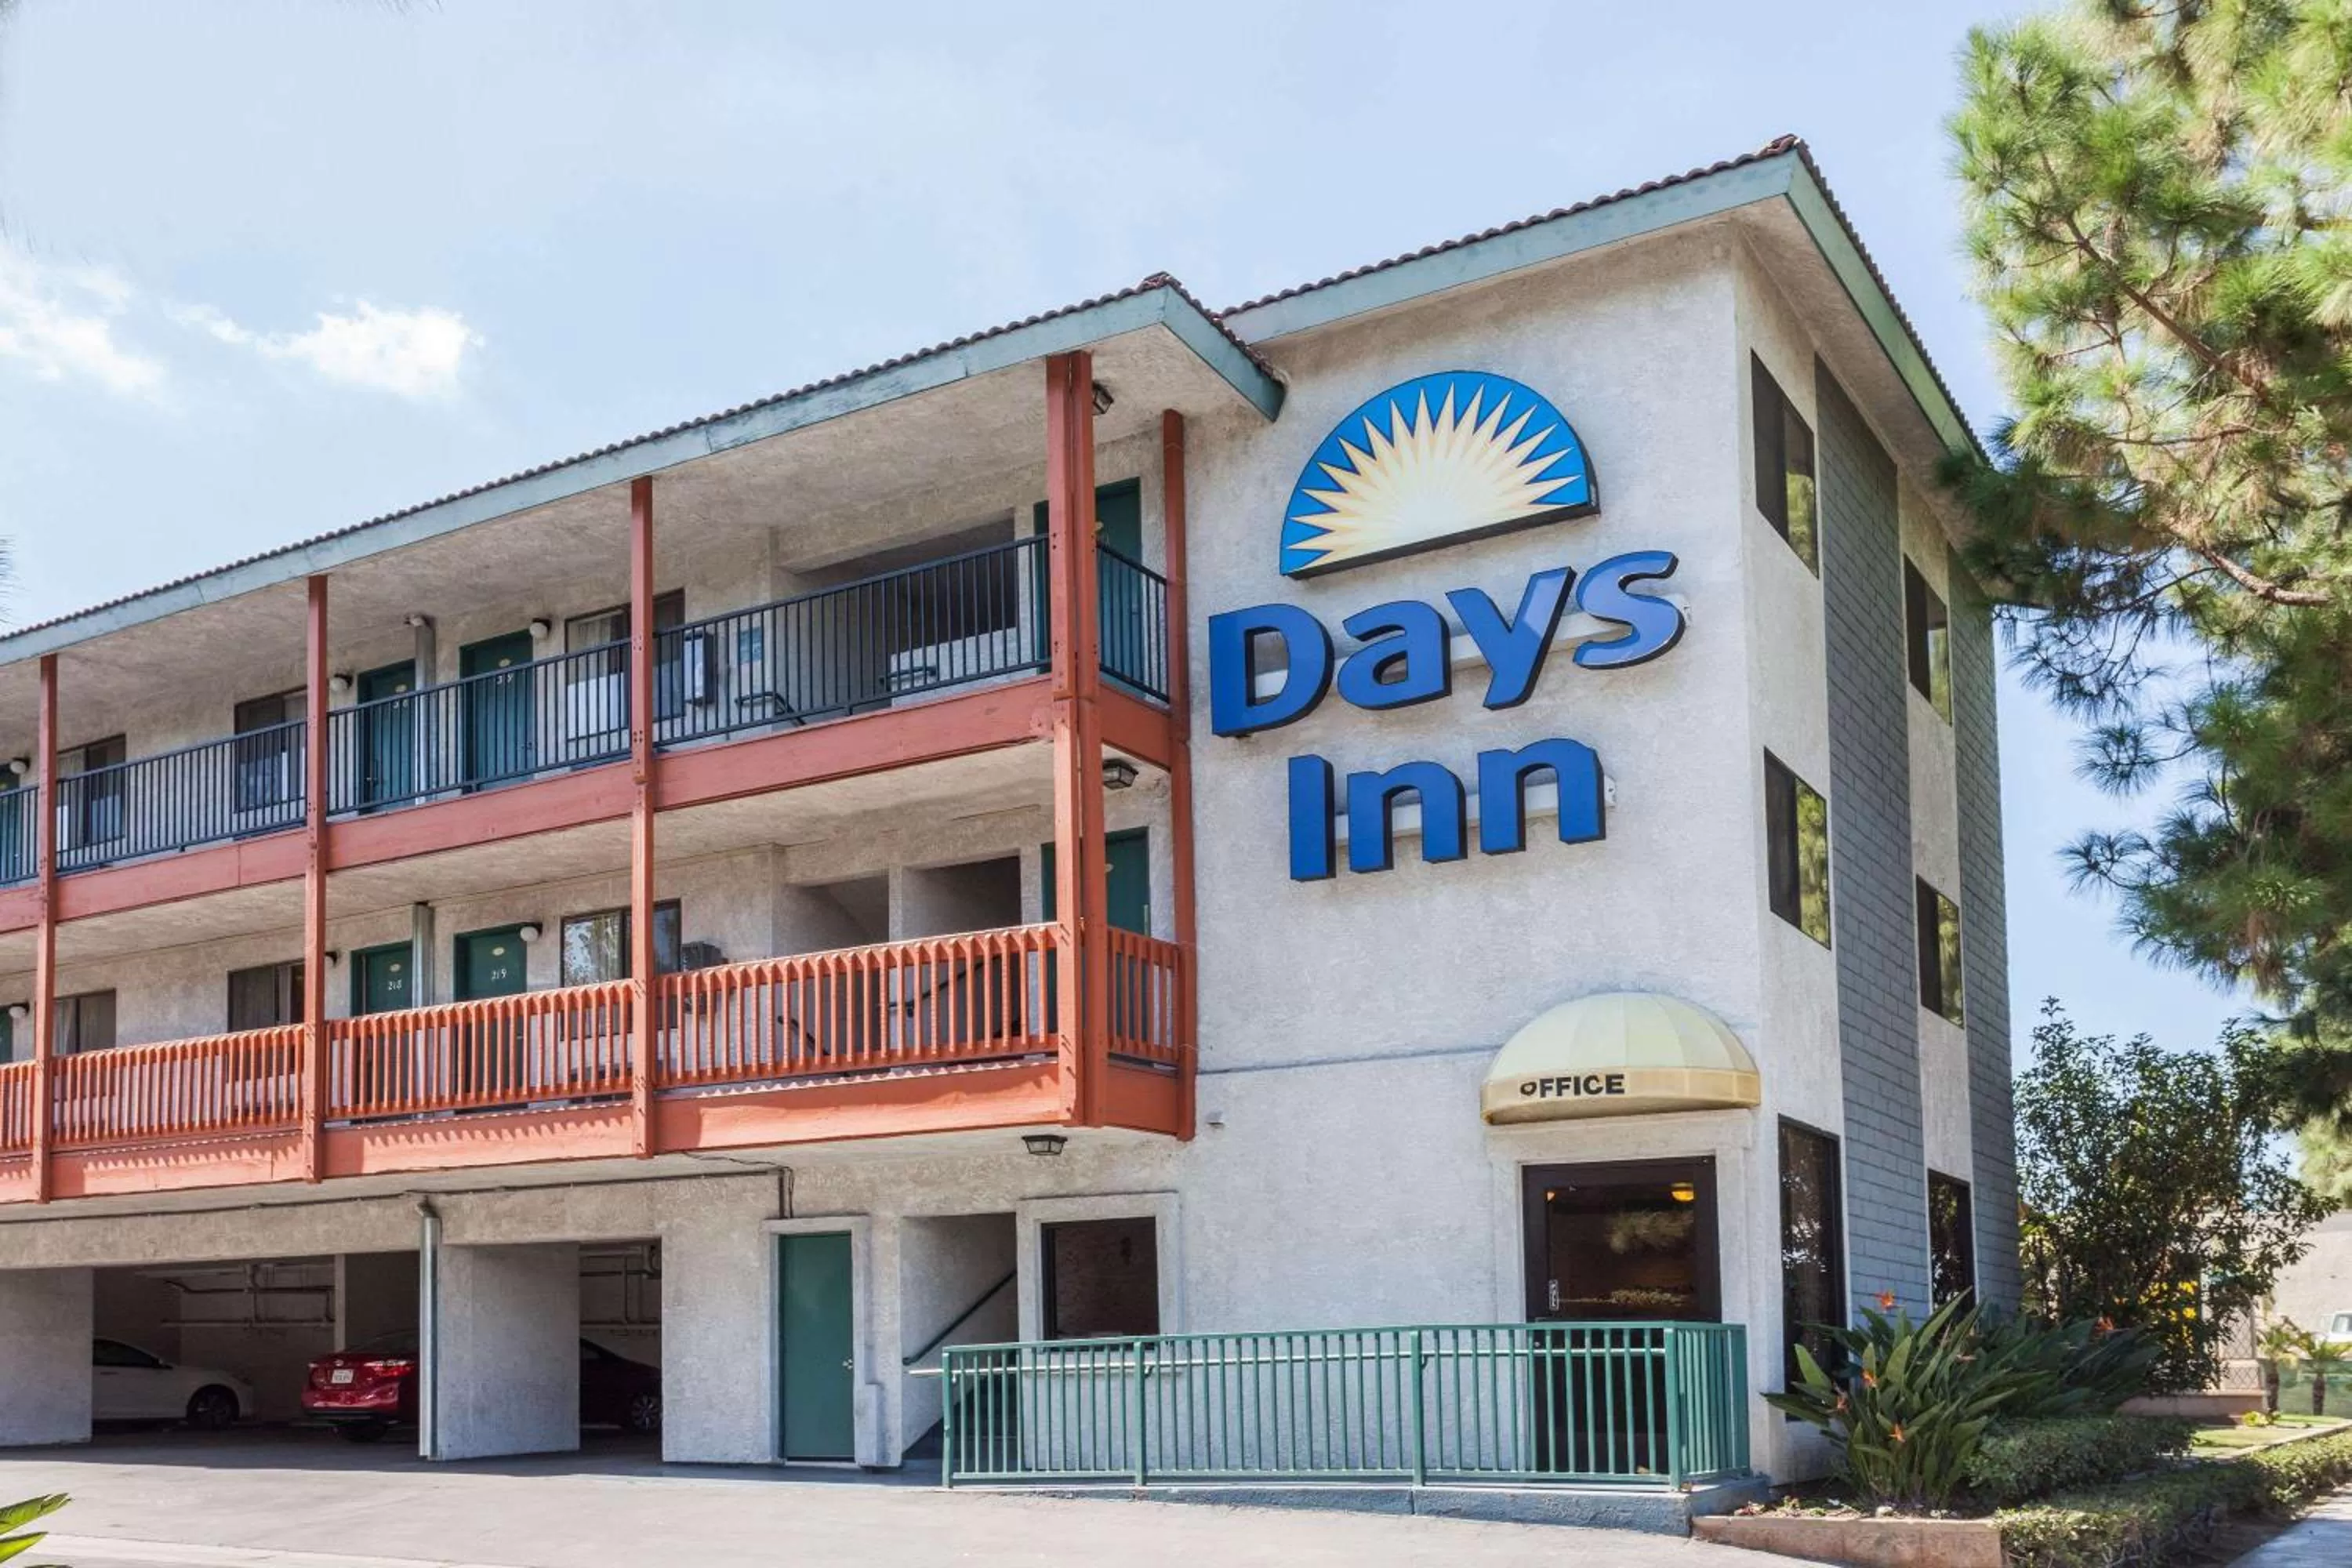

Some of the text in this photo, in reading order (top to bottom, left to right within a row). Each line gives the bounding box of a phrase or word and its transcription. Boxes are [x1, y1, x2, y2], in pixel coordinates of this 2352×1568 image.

[1208, 550, 1685, 736] Days
[1288, 739, 1606, 881] Inn
[1519, 1074, 1625, 1098] OFFICE
